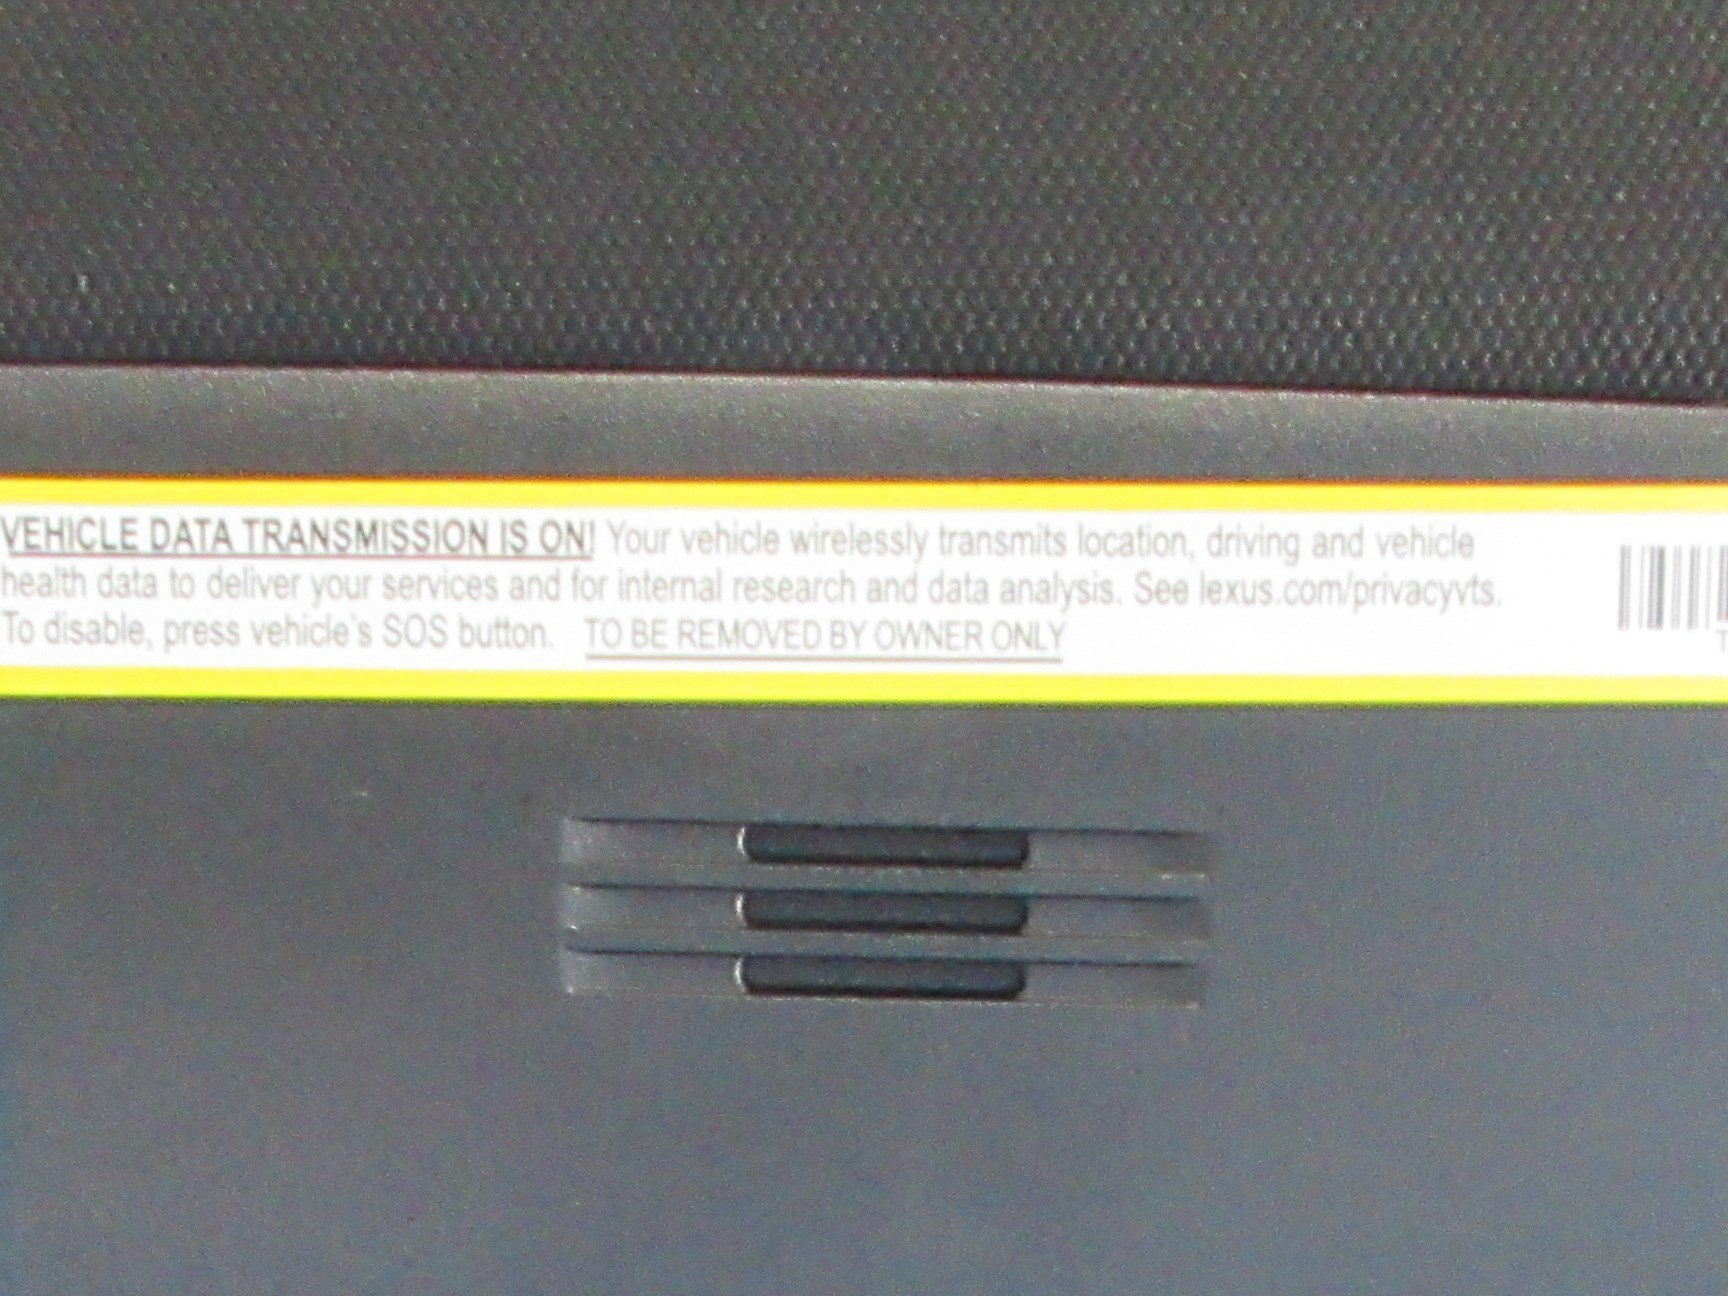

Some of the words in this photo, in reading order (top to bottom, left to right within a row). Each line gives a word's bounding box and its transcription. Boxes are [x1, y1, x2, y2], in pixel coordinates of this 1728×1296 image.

[0, 515, 138, 553] VEHICLE
[151, 517, 231, 553] DATA
[243, 517, 489, 555] TRANSMISSION
[500, 518, 529, 555] IS
[539, 519, 596, 556] ON!
[606, 519, 670, 556] Your
[680, 520, 780, 557] vehicle
[789, 520, 928, 563] wirelessly
[939, 522, 1068, 558] transmits
[1077, 523, 1197, 563] location,
[1206, 523, 1300, 567] driving
[1311, 524, 1365, 559] and
[1374, 524, 1475, 560] vehicle
[0, 564, 87, 599] health
[97, 565, 159, 600] data
[169, 567, 195, 600] to
[207, 566, 300, 600] deliver
[310, 574, 372, 609] your
[382, 567, 499, 602] services
[508, 567, 561, 602] and
[571, 567, 608, 602] for
[618, 568, 723, 603] internal
[732, 568, 856, 604] research
[867, 569, 919, 604] and
[927, 569, 990, 605] data
[1000, 570, 1122, 614] analysis.
[1133, 570, 1190, 606] See
[2, 610, 35, 646] To
[44, 611, 153, 652] disable,
[164, 620, 241, 654] press
[251, 612, 372, 648] vehicle's
[382, 613, 447, 649] SOS
[459, 613, 556, 650] button.
[584, 617, 622, 650] TO
[631, 617, 668, 650] BE
[677, 617, 821, 652] REMOVED
[830, 618, 868, 652] BY
[874, 618, 984, 653] OWNER
[991, 619, 1066, 653] ONLY
